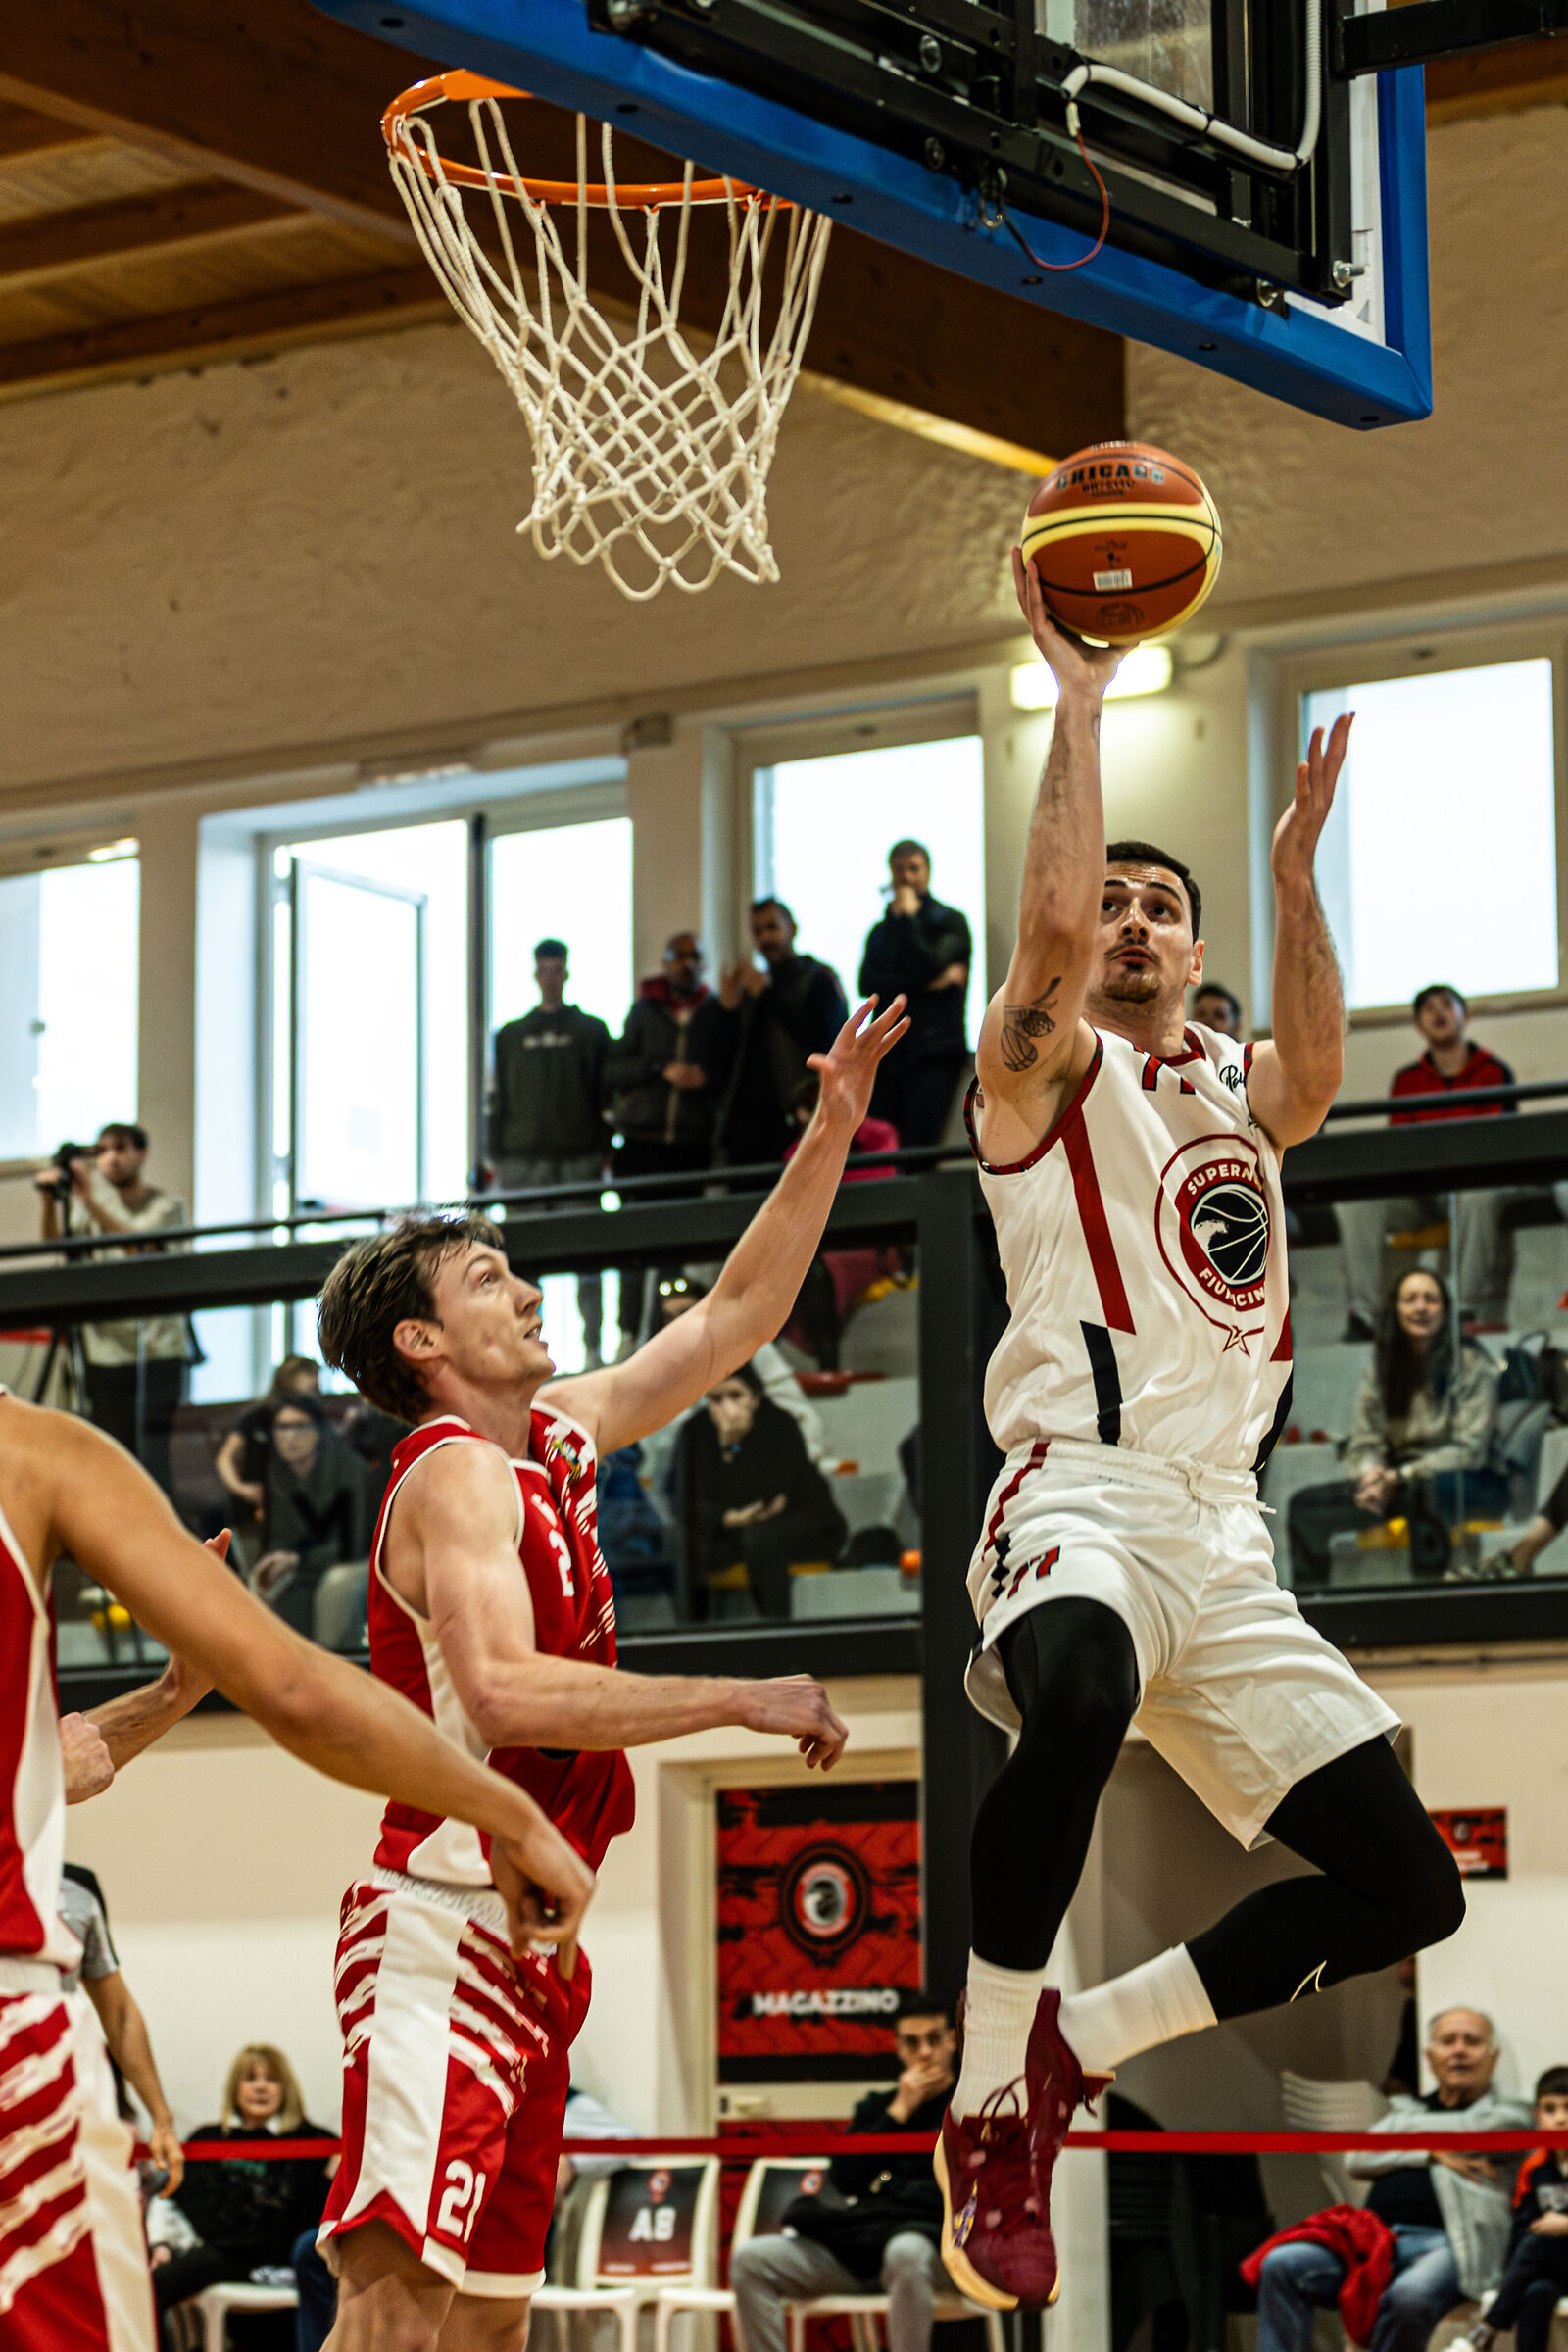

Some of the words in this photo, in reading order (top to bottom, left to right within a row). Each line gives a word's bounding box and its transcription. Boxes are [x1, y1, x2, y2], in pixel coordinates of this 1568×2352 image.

[1187, 1163, 1259, 1195] SUPERN
[752, 1989, 900, 2016] MAGAZZINO
[437, 2159, 486, 2243] 21
